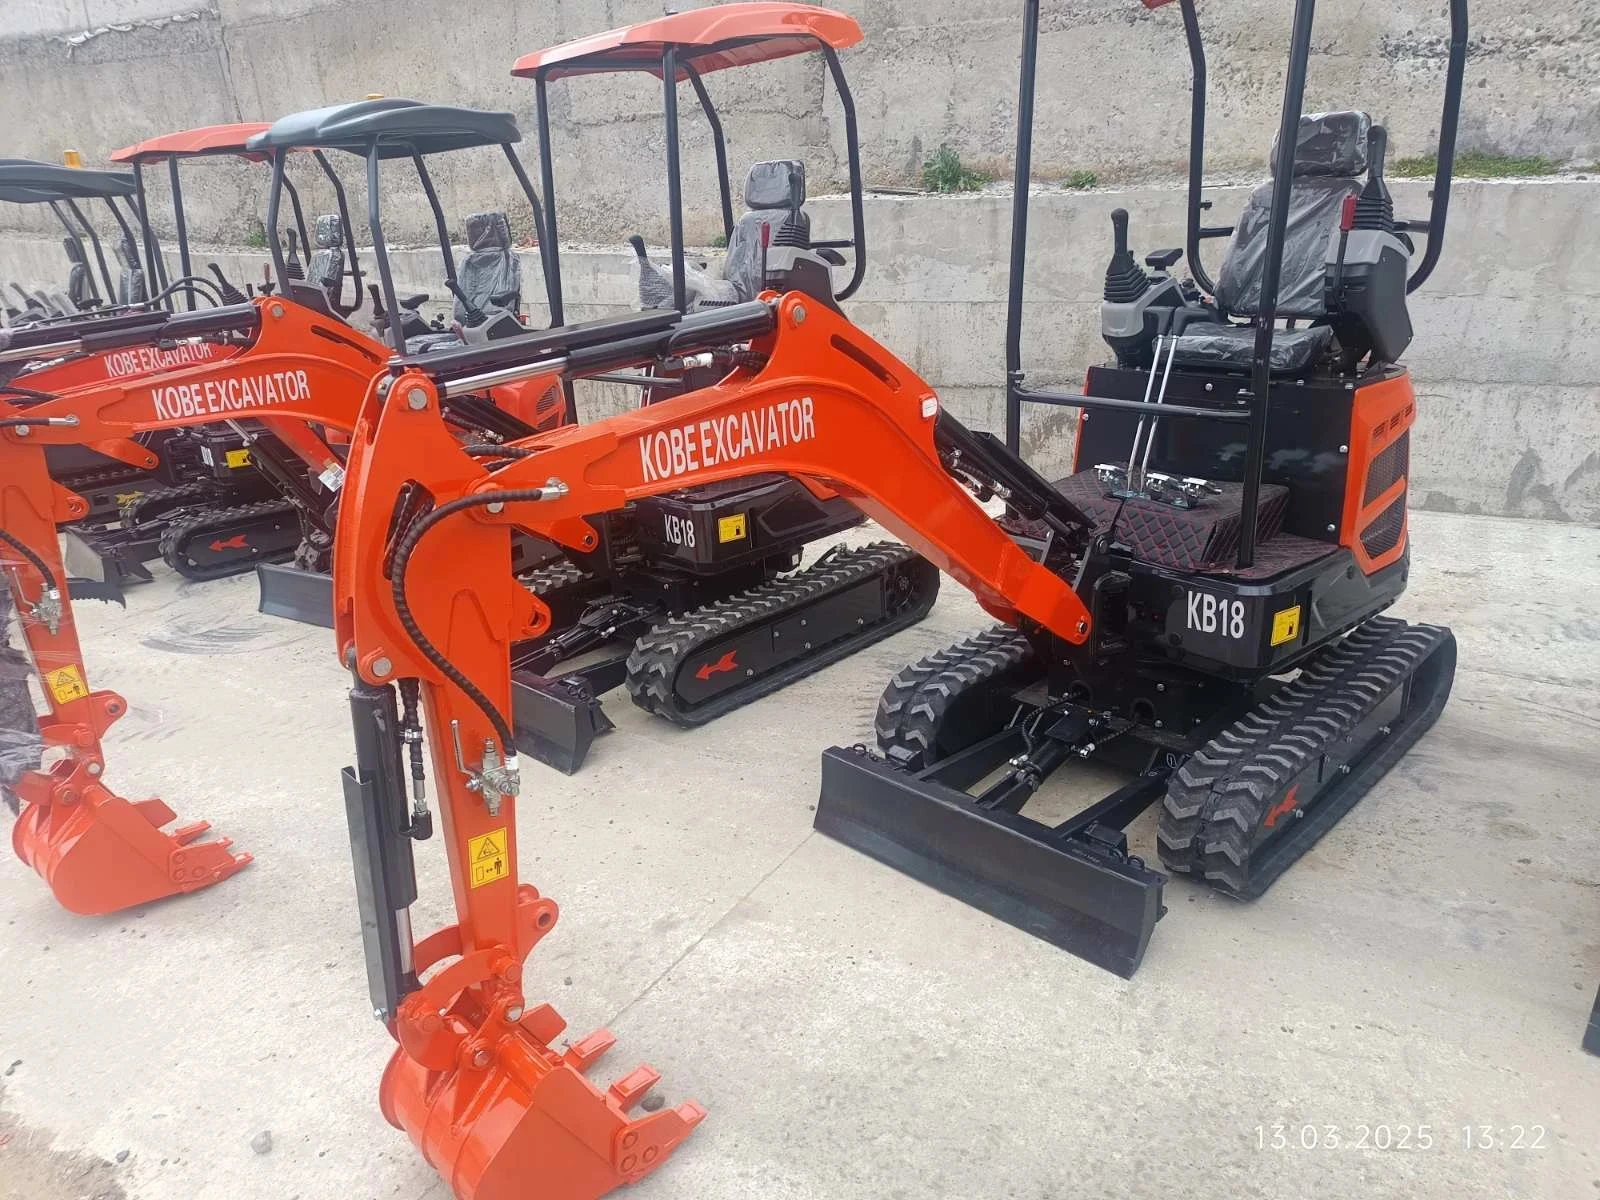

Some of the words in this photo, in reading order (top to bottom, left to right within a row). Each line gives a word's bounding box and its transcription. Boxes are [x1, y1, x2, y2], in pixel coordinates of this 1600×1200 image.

[104, 351, 141, 377] KOBE
[152, 383, 205, 420] KOBE
[204, 369, 311, 413] EXCAVATOR
[639, 424, 699, 483] KOBE
[700, 396, 816, 468] EXCAVATOR
[664, 513, 696, 548] KB18
[1187, 590, 1245, 639] KB18
